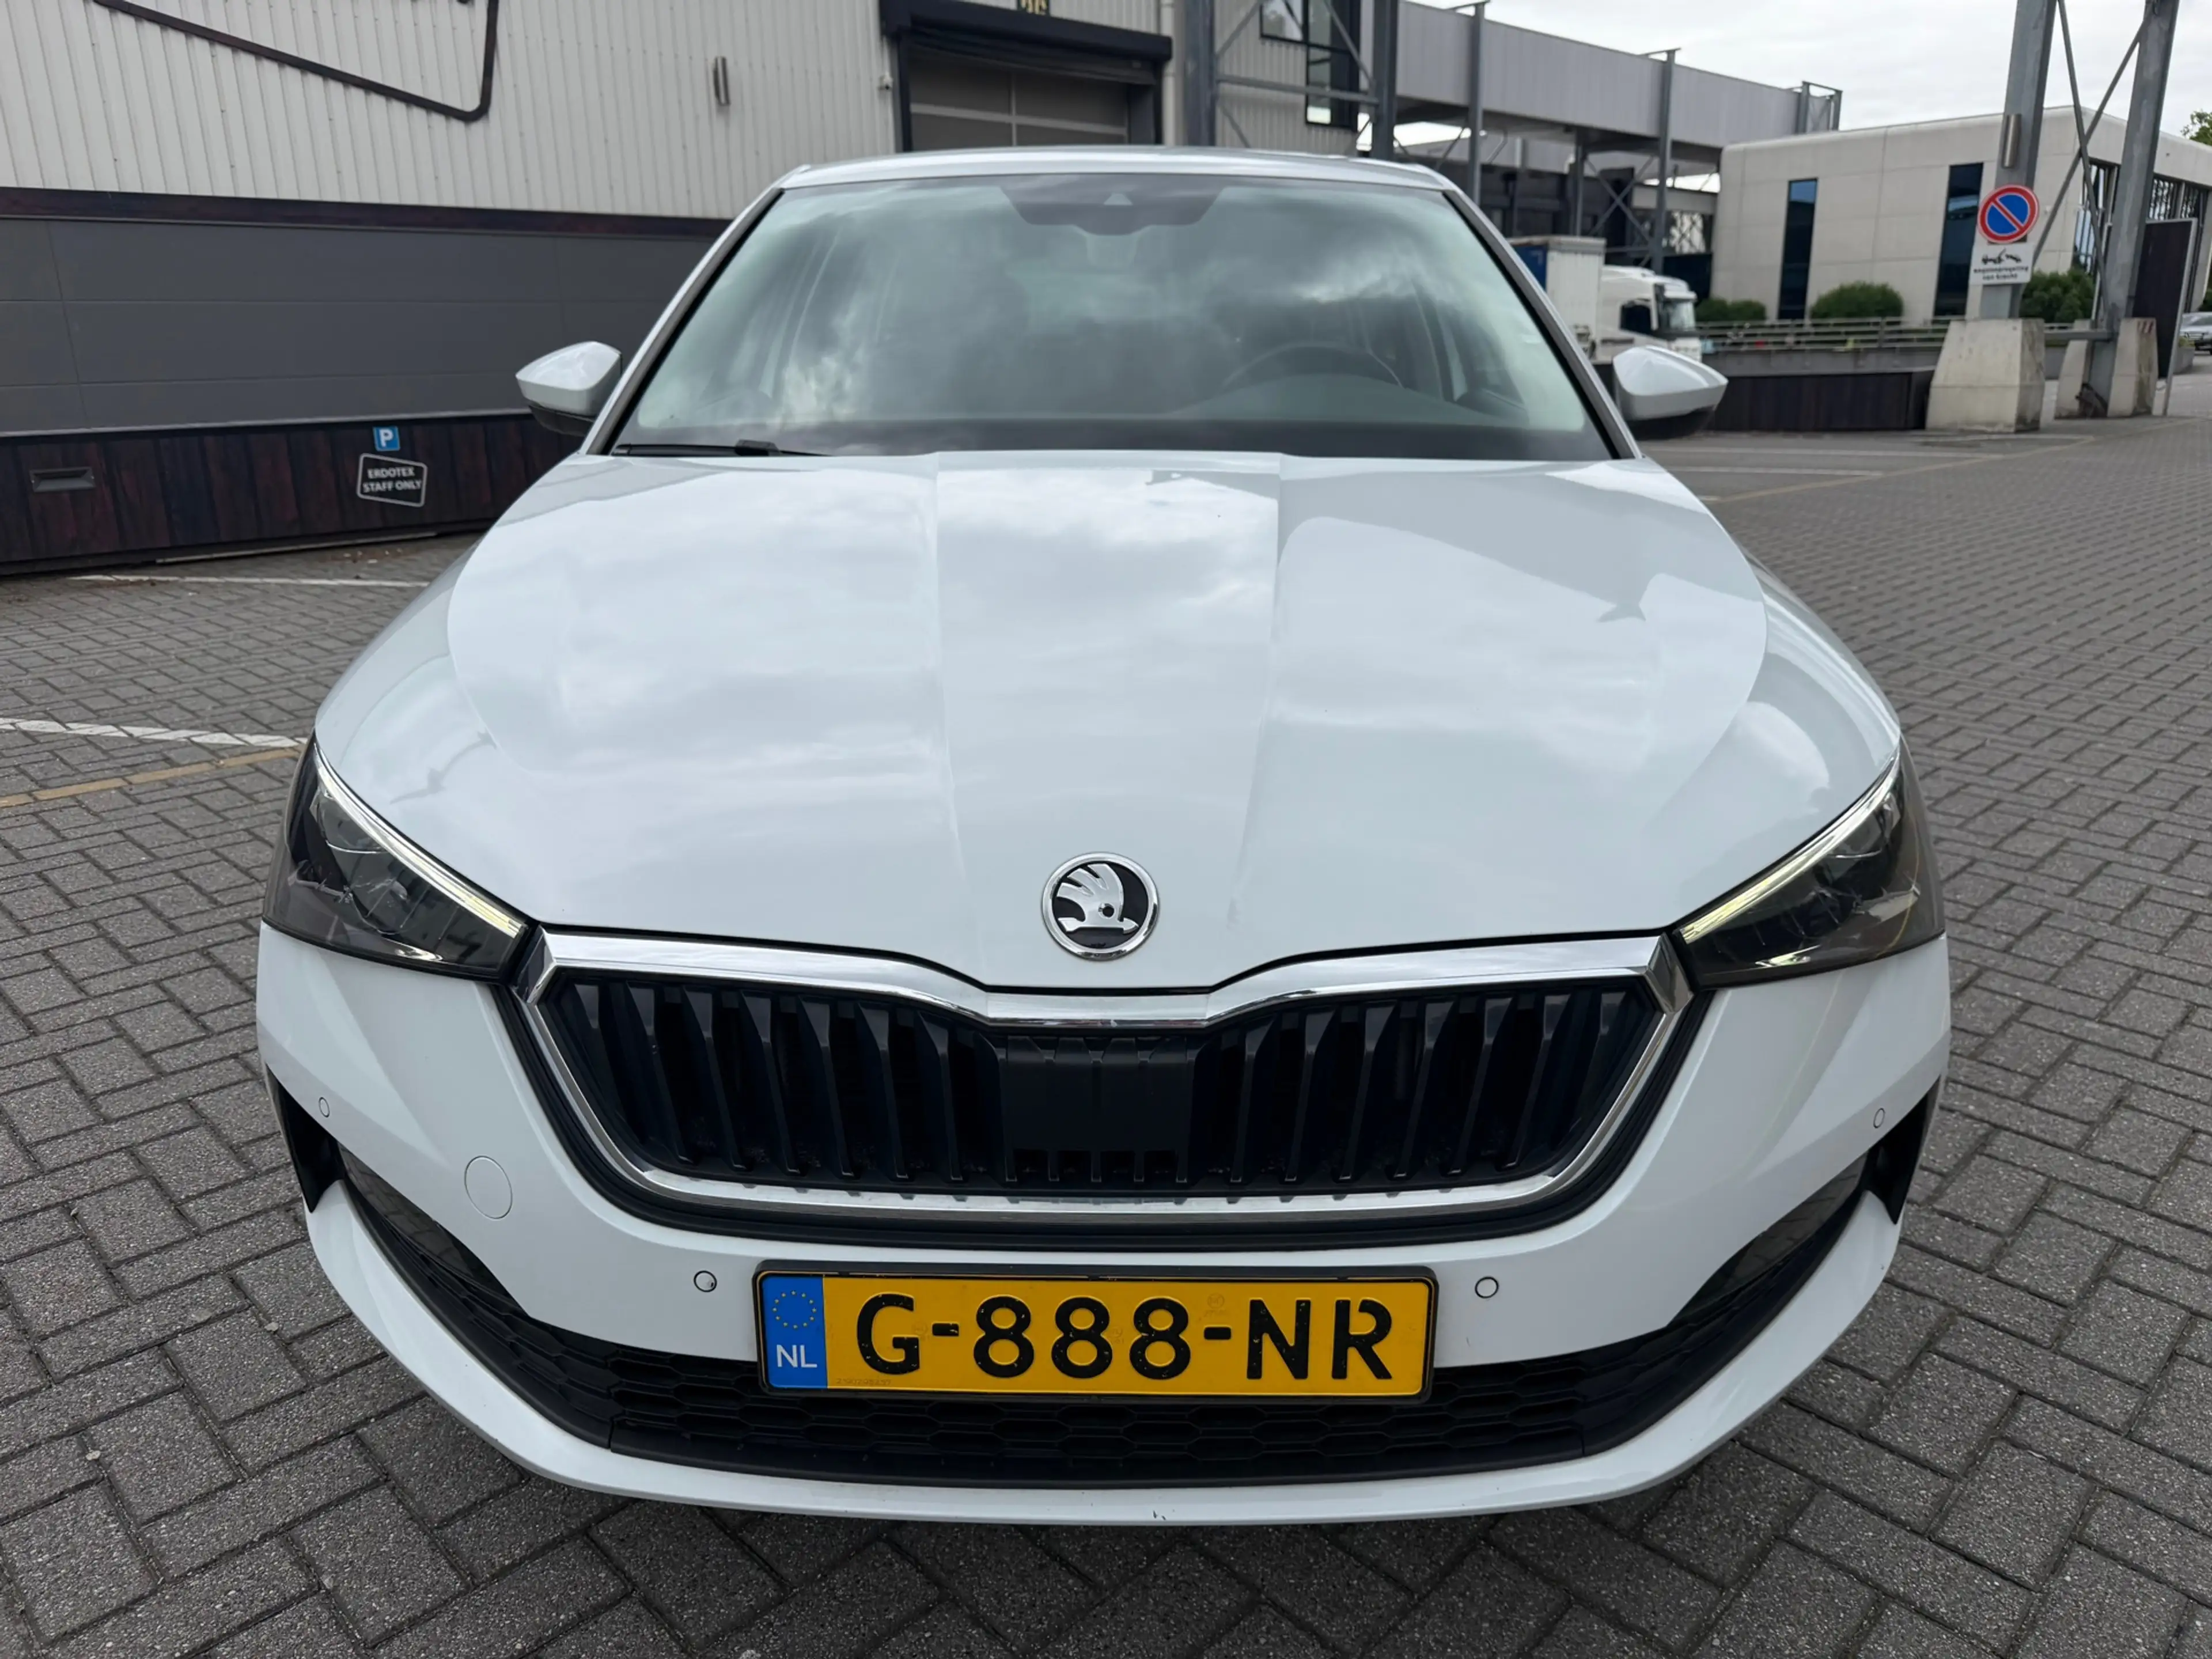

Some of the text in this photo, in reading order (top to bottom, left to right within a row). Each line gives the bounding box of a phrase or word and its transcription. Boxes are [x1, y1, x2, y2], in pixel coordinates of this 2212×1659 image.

[378, 429, 394, 447] P
[362, 479, 422, 493] STAFF ONLY
[857, 1293, 1392, 1380] G-888-NR
[777, 1344, 817, 1368] NL
